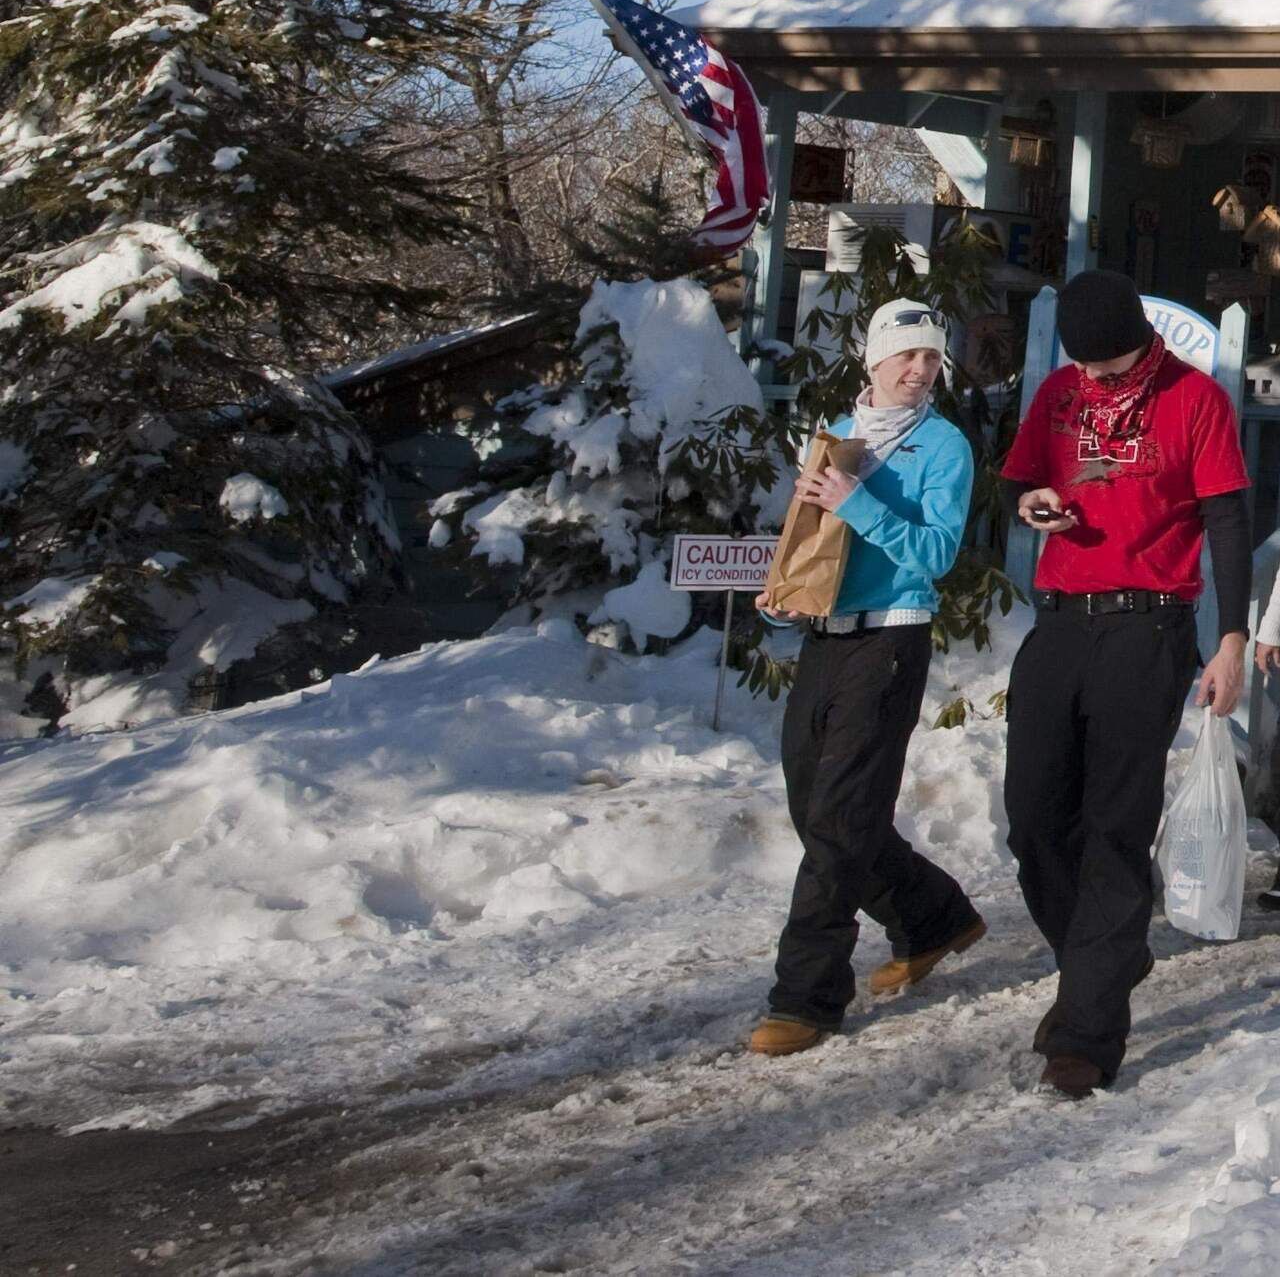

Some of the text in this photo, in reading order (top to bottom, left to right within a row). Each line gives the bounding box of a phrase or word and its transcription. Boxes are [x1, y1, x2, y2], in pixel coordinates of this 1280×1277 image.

[1143, 308, 1210, 356] HOP
[686, 544, 777, 565] CAUTION
[681, 568, 702, 581] ICY
